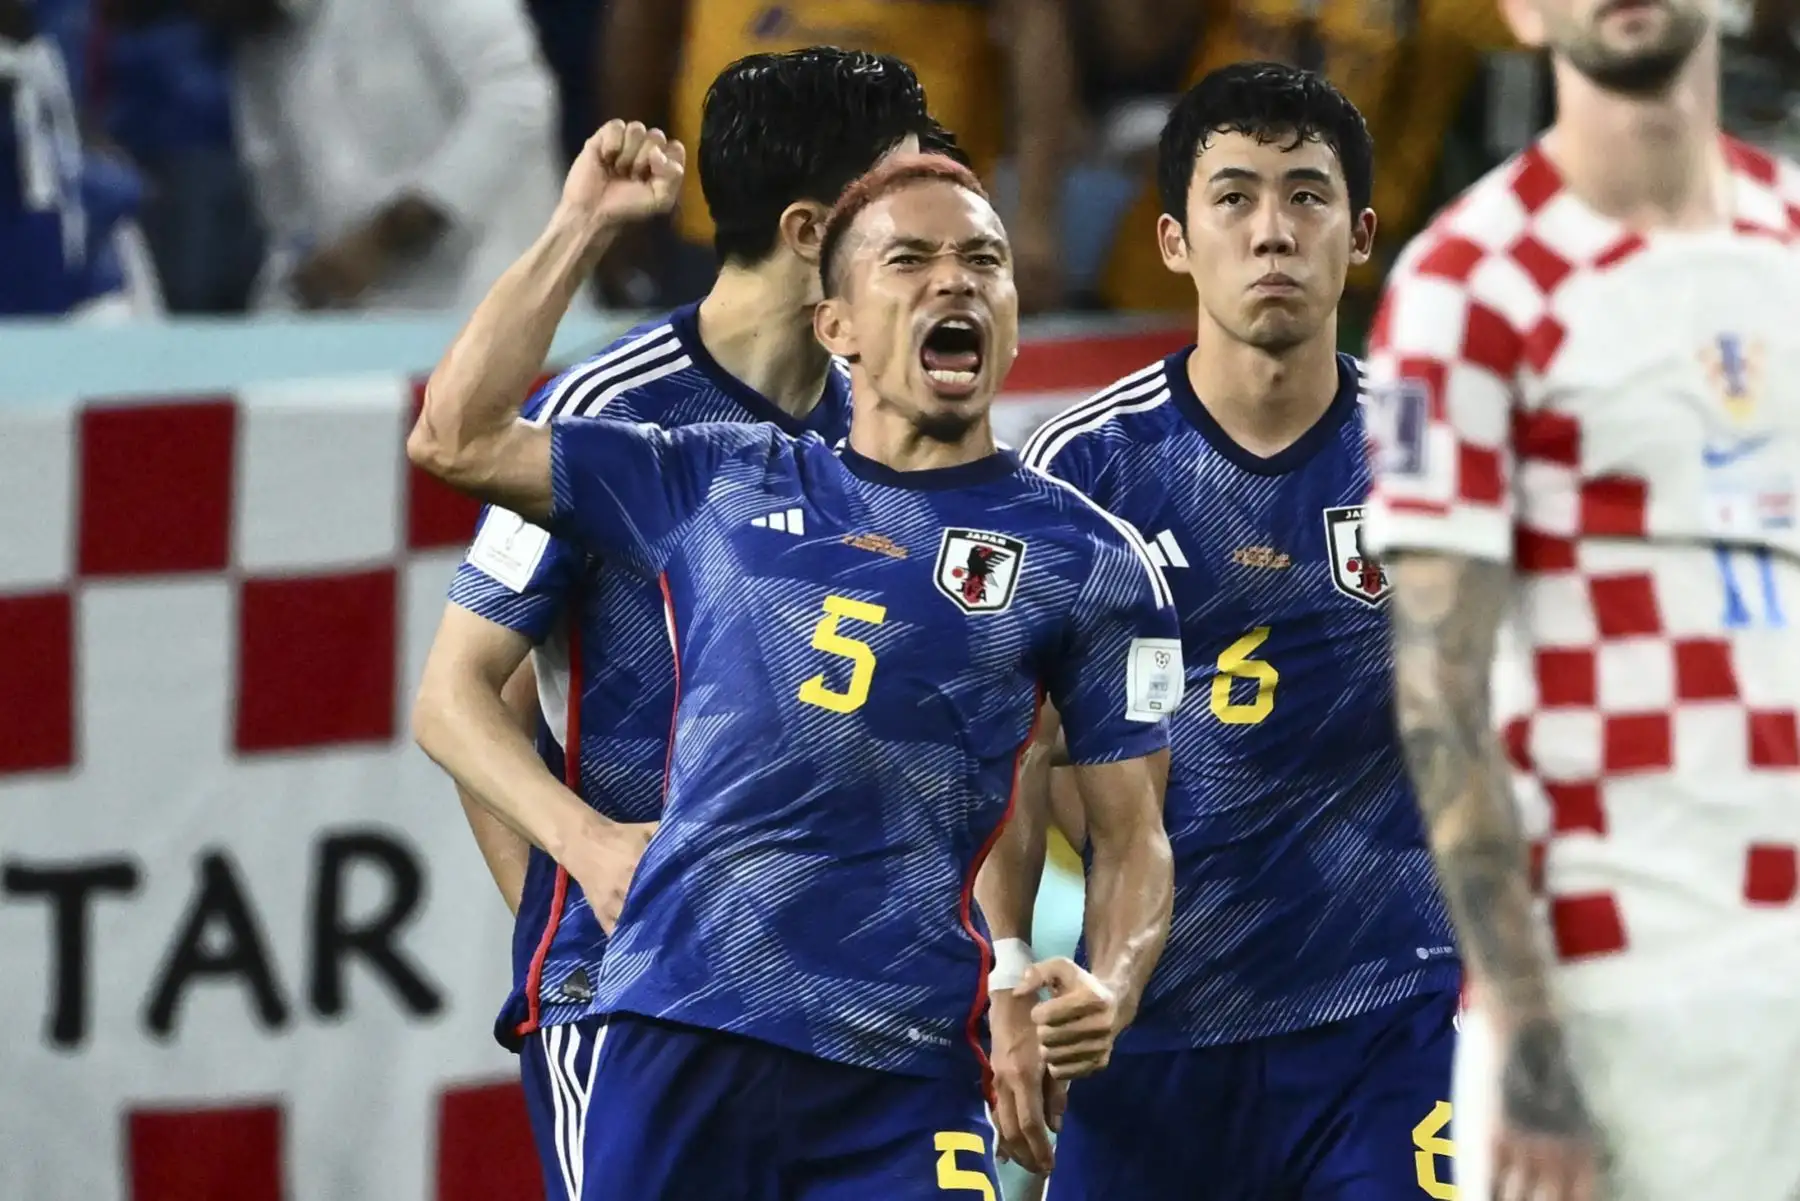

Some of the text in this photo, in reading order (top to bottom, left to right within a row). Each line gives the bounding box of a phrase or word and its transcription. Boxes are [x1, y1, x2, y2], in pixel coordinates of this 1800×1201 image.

[965, 532, 1007, 546] JAPAN
[798, 595, 887, 714] 5
[1210, 626, 1279, 724] 6
[2, 827, 446, 1051] TAR
[934, 1131, 997, 1201] 5
[1411, 1100, 1460, 1200] 6
